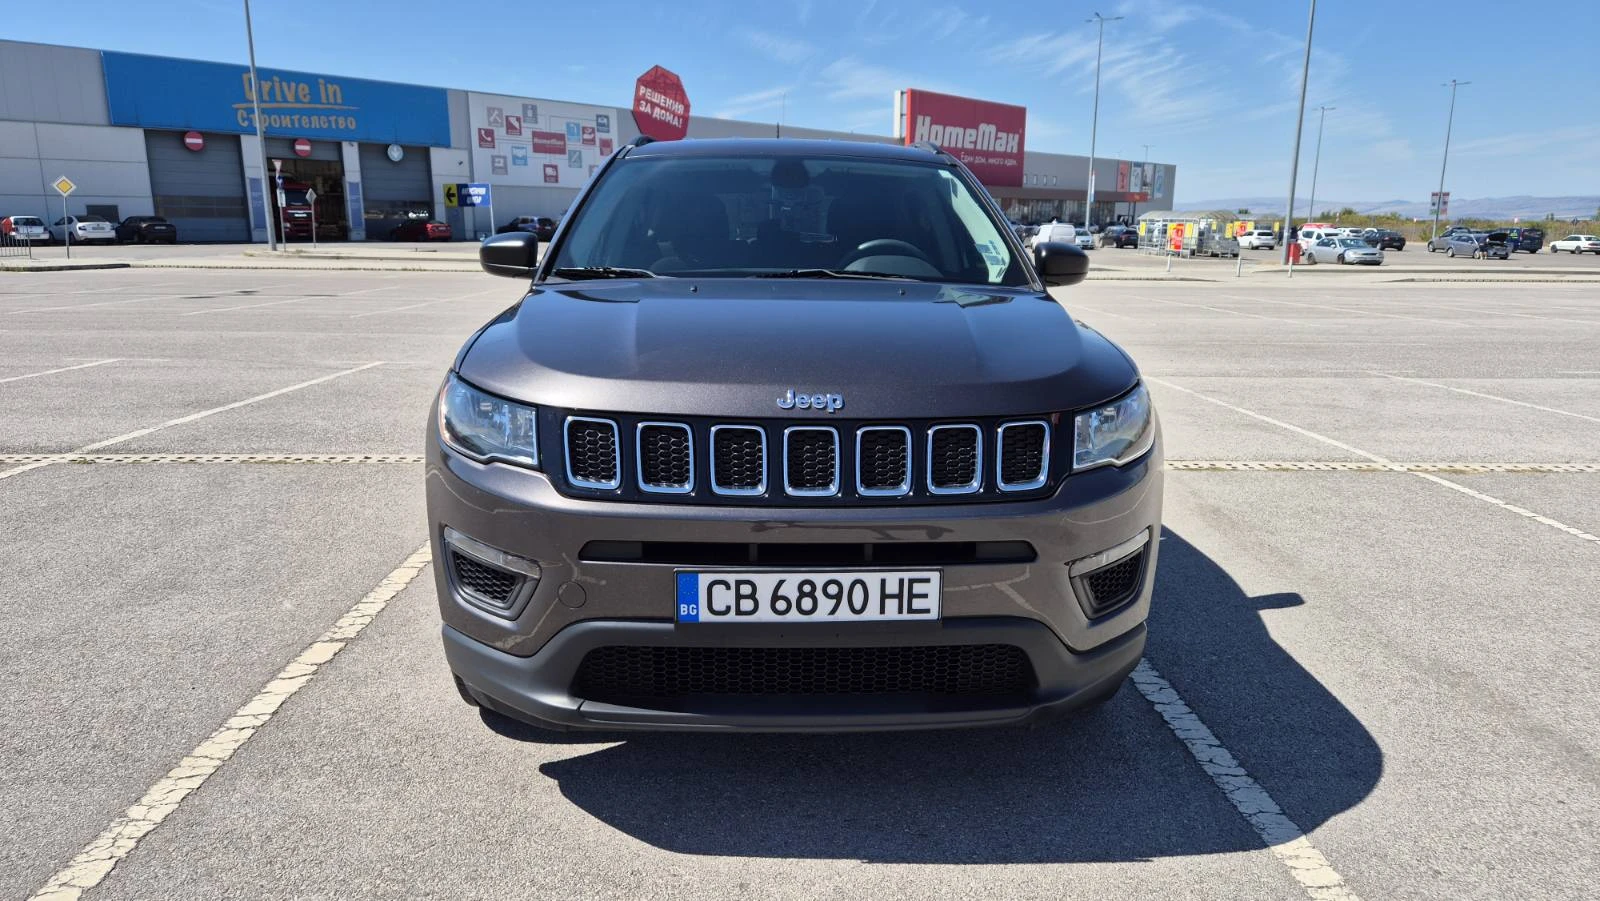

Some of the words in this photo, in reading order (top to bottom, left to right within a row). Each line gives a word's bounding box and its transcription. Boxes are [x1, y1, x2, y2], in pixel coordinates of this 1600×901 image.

[242, 72, 311, 102] Drive
[318, 79, 342, 104] in
[639, 85, 685, 115] РЕШЕНИЯ
[639, 100, 652, 114] ЗА
[652, 106, 683, 128] ДОМА!
[914, 115, 1019, 153] HomeMax
[776, 387, 844, 413] Jeep
[680, 603, 698, 616] BG
[706, 579, 760, 617] CB
[769, 578, 870, 616] 6890
[879, 577, 932, 616] HE
